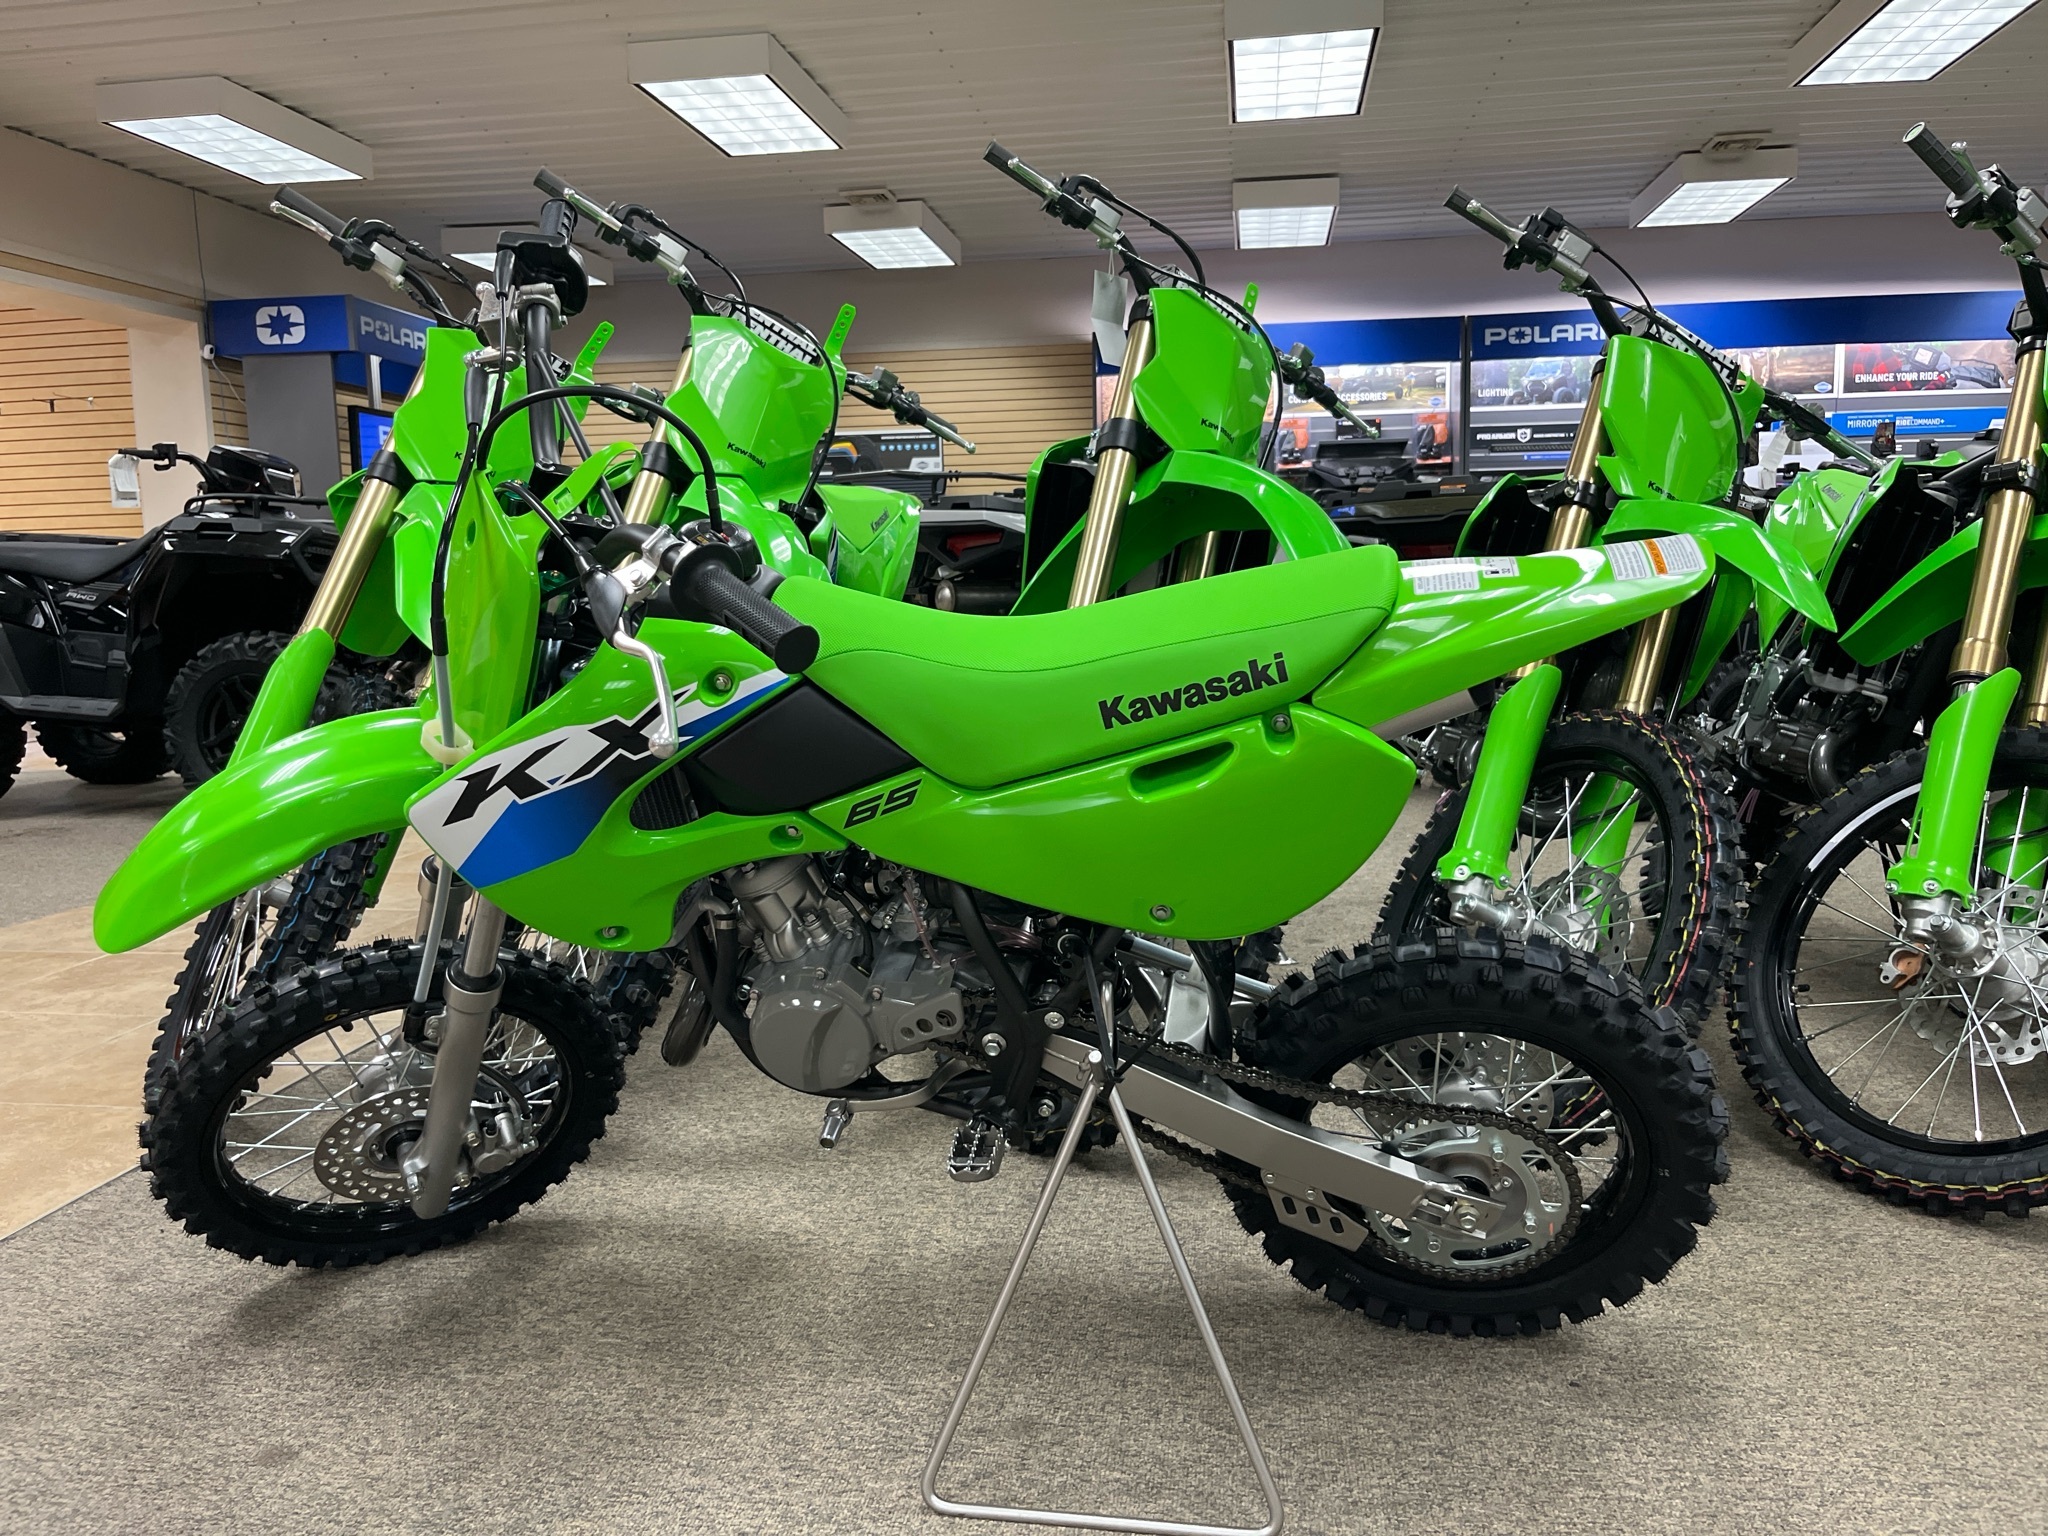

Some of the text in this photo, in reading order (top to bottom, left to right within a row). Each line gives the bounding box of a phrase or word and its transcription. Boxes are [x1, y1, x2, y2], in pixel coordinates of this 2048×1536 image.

[360, 315, 426, 350] POLAR
[1477, 387, 1514, 398] LIGHTING
[1855, 371, 1939, 383] ENHANCE YOUR RIDE
[727, 441, 767, 469] Kawasaki
[1097, 651, 1290, 730] Kawasaki
[442, 681, 697, 827] KX
[843, 778, 923, 830] 65
